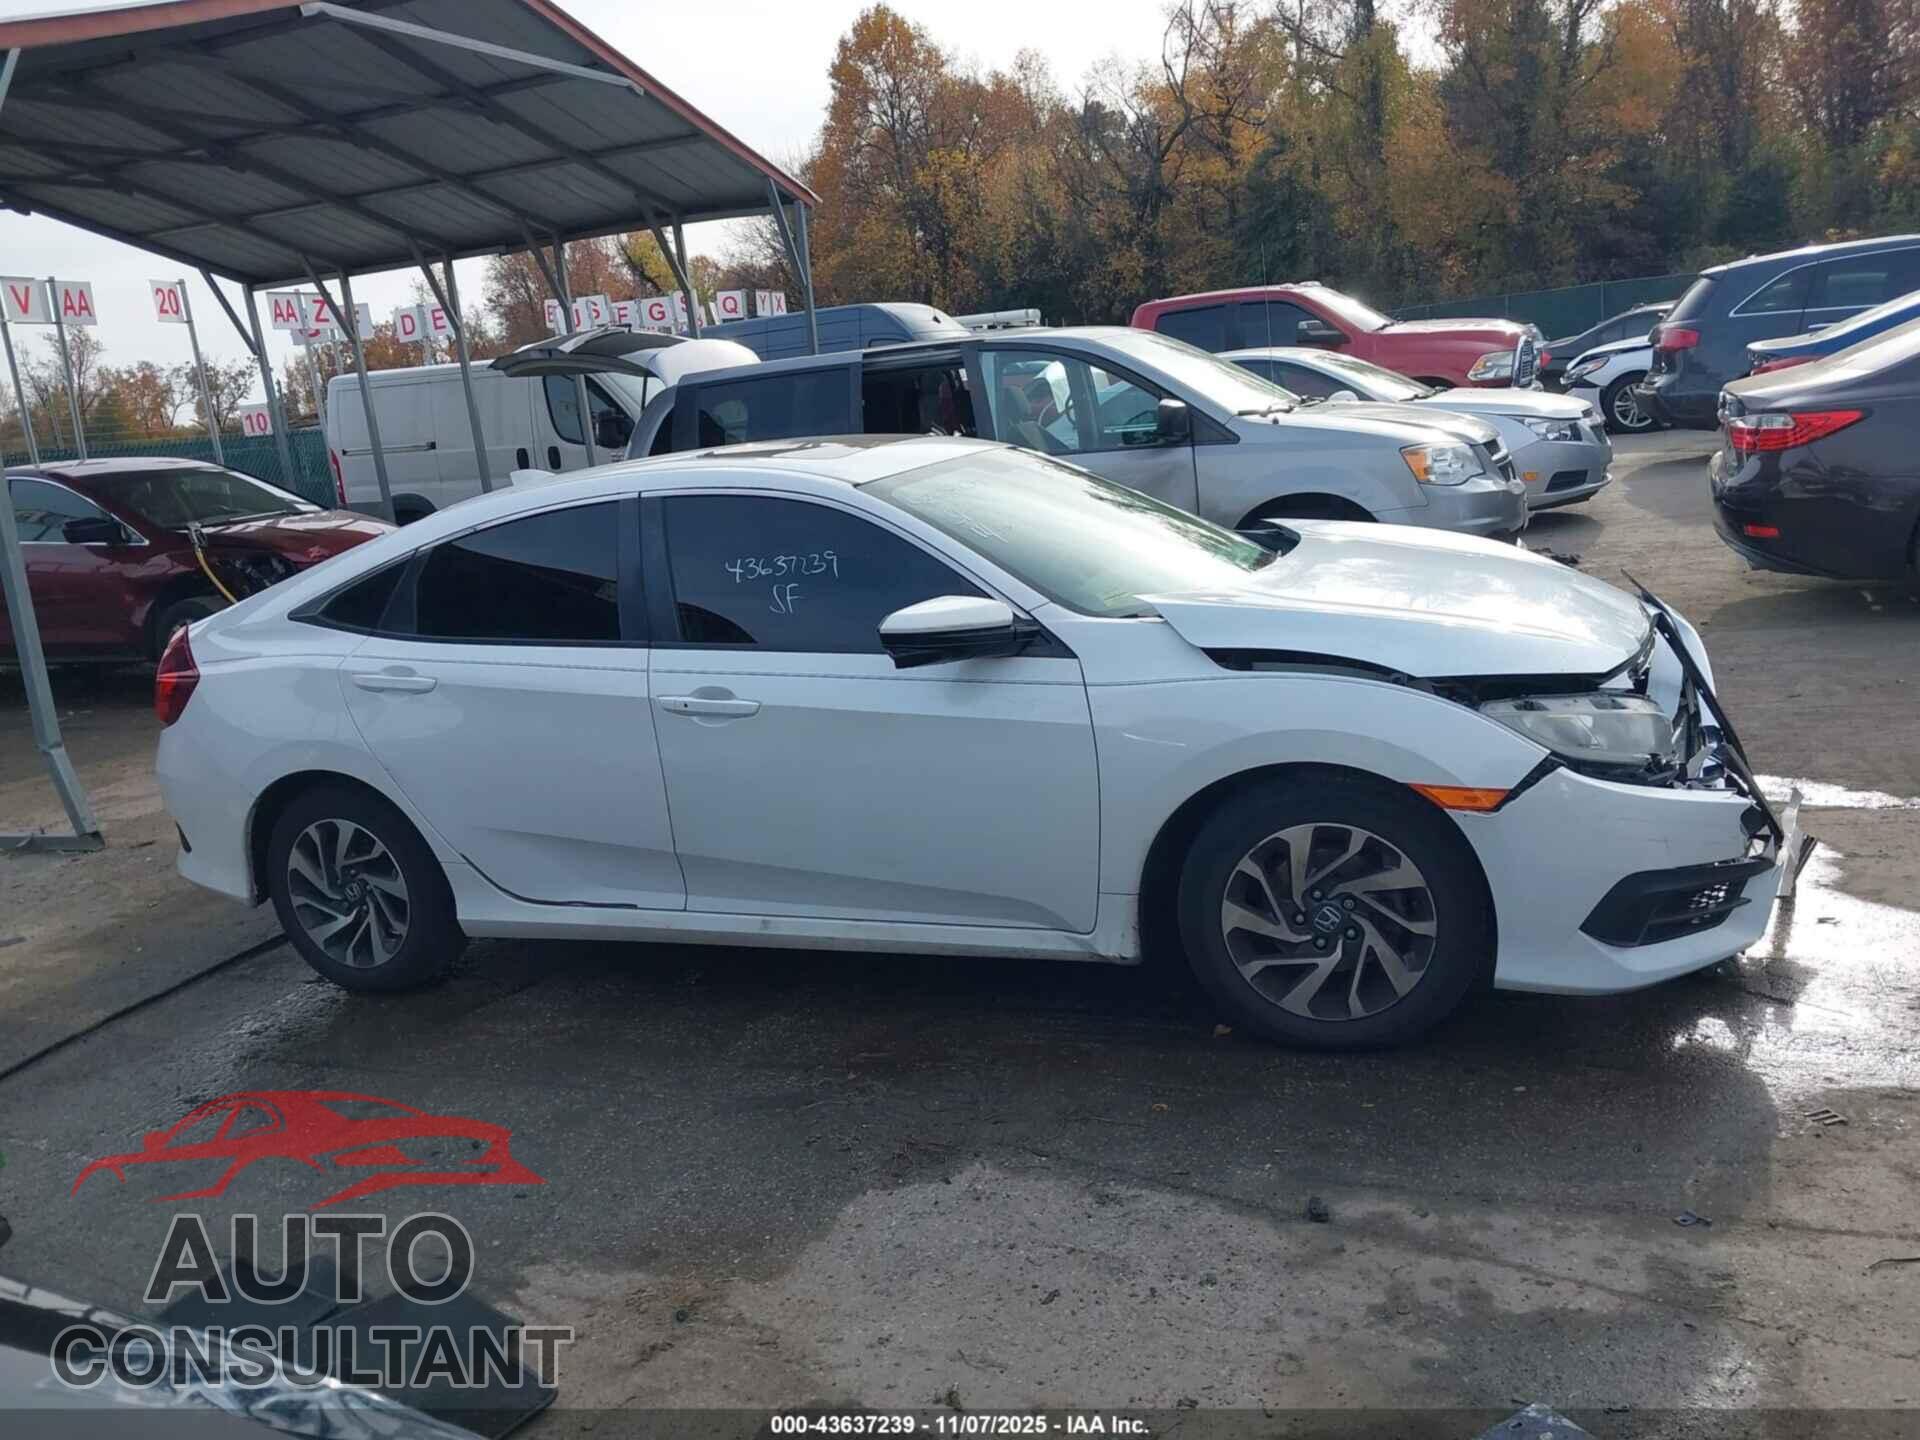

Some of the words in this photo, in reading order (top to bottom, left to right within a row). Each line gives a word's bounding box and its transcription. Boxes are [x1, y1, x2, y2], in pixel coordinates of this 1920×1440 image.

[9, 285, 30, 314] V
[63, 288, 92, 317] AA
[155, 287, 180, 315] 20
[274, 299, 298, 322] AA
[312, 298, 330, 322] Z
[722, 296, 738, 314] Q
[775, 295, 784, 312] X
[431, 308, 446, 330] E
[649, 302, 666, 321] G
[401, 314, 415, 335] D
[244, 413, 268, 433] 10
[725, 550, 839, 583] 43637239
